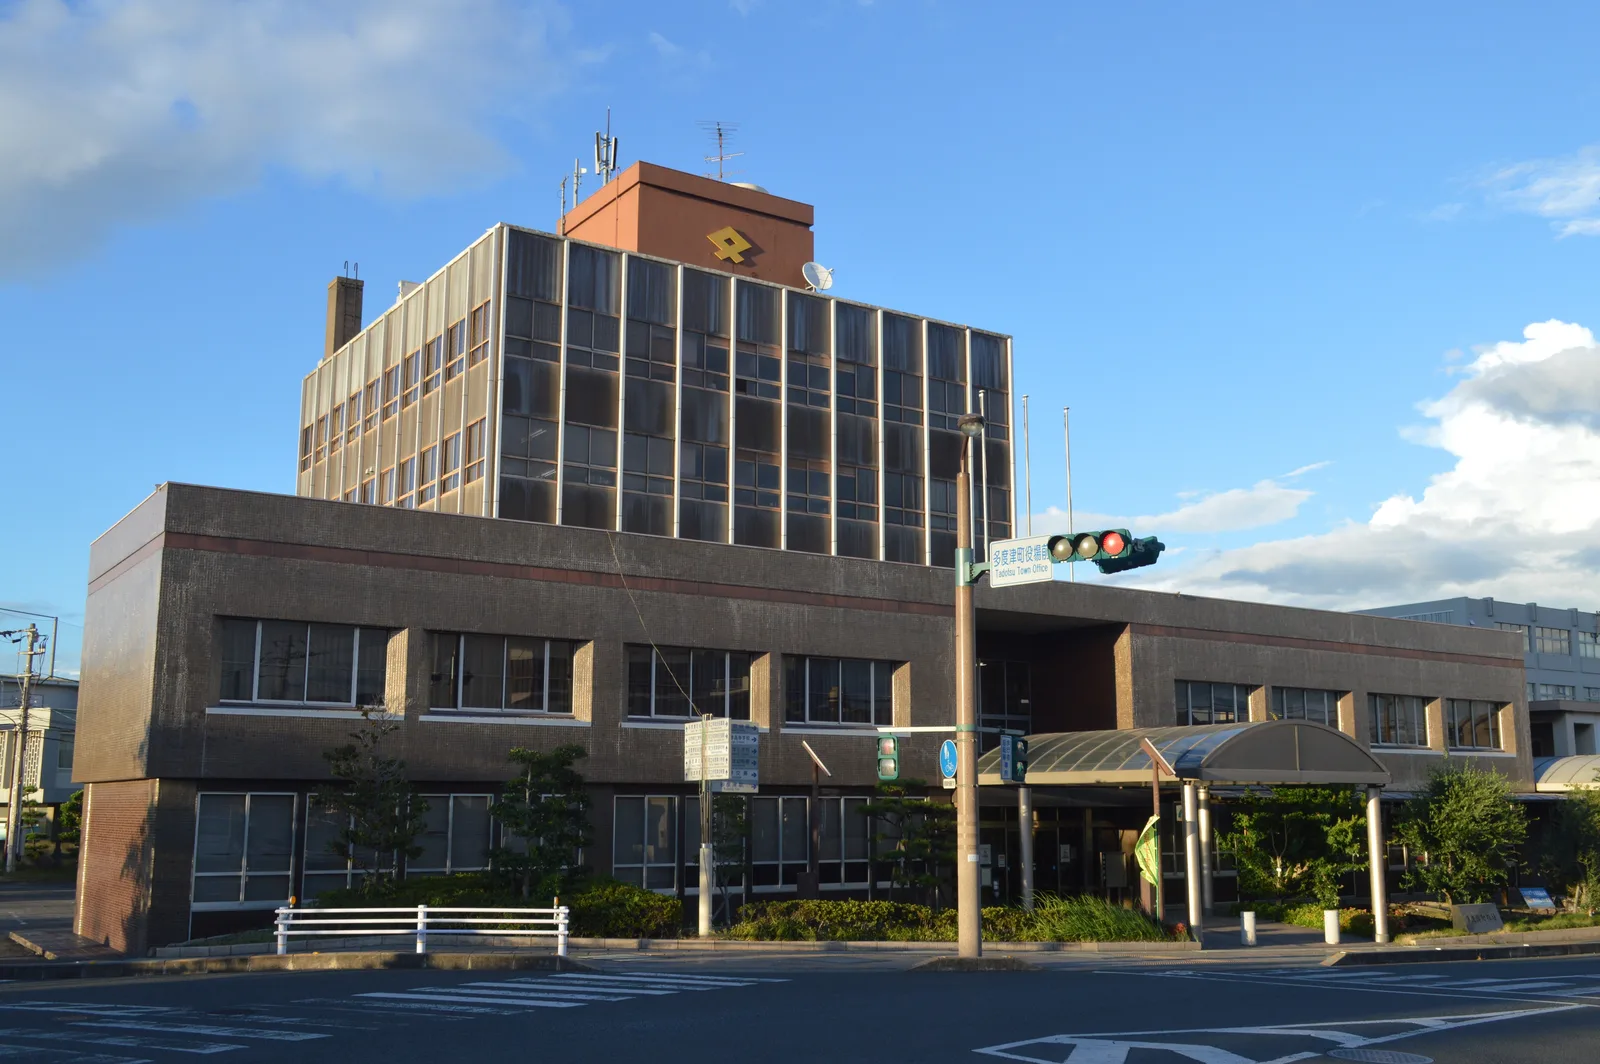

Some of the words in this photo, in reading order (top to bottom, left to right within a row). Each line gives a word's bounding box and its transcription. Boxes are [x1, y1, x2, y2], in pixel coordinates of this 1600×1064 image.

[995, 568, 1015, 578] Tadotsu
[1017, 566, 1031, 575] Town
[1032, 564, 1048, 573] Office
